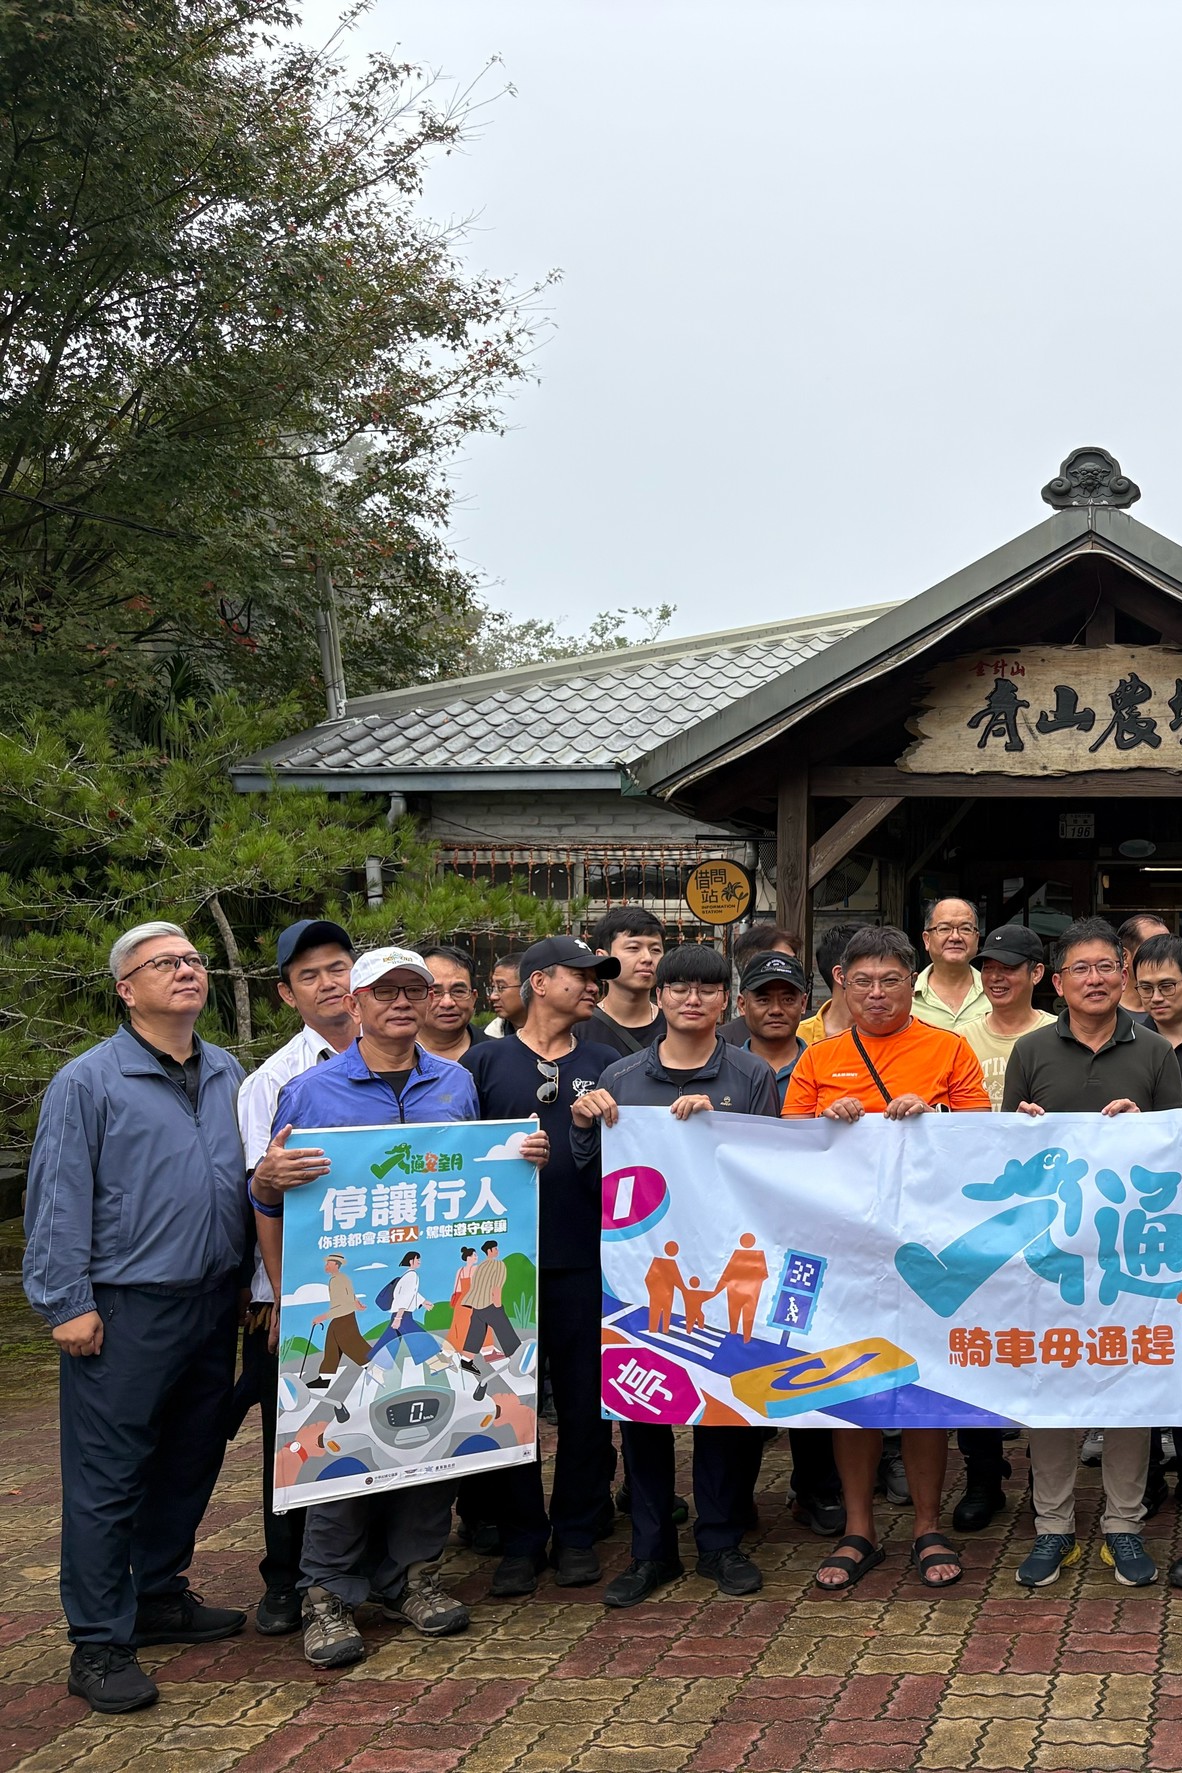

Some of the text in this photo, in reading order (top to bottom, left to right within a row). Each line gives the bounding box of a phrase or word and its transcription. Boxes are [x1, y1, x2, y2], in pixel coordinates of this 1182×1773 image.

[1071, 826, 1091, 838] 196
[695, 868, 727, 890] 借問
[701, 889, 718, 903] 站
[319, 1176, 508, 1231] 停讓行人
[789, 1260, 815, 1287] 32
[608, 1357, 673, 1416] 停
